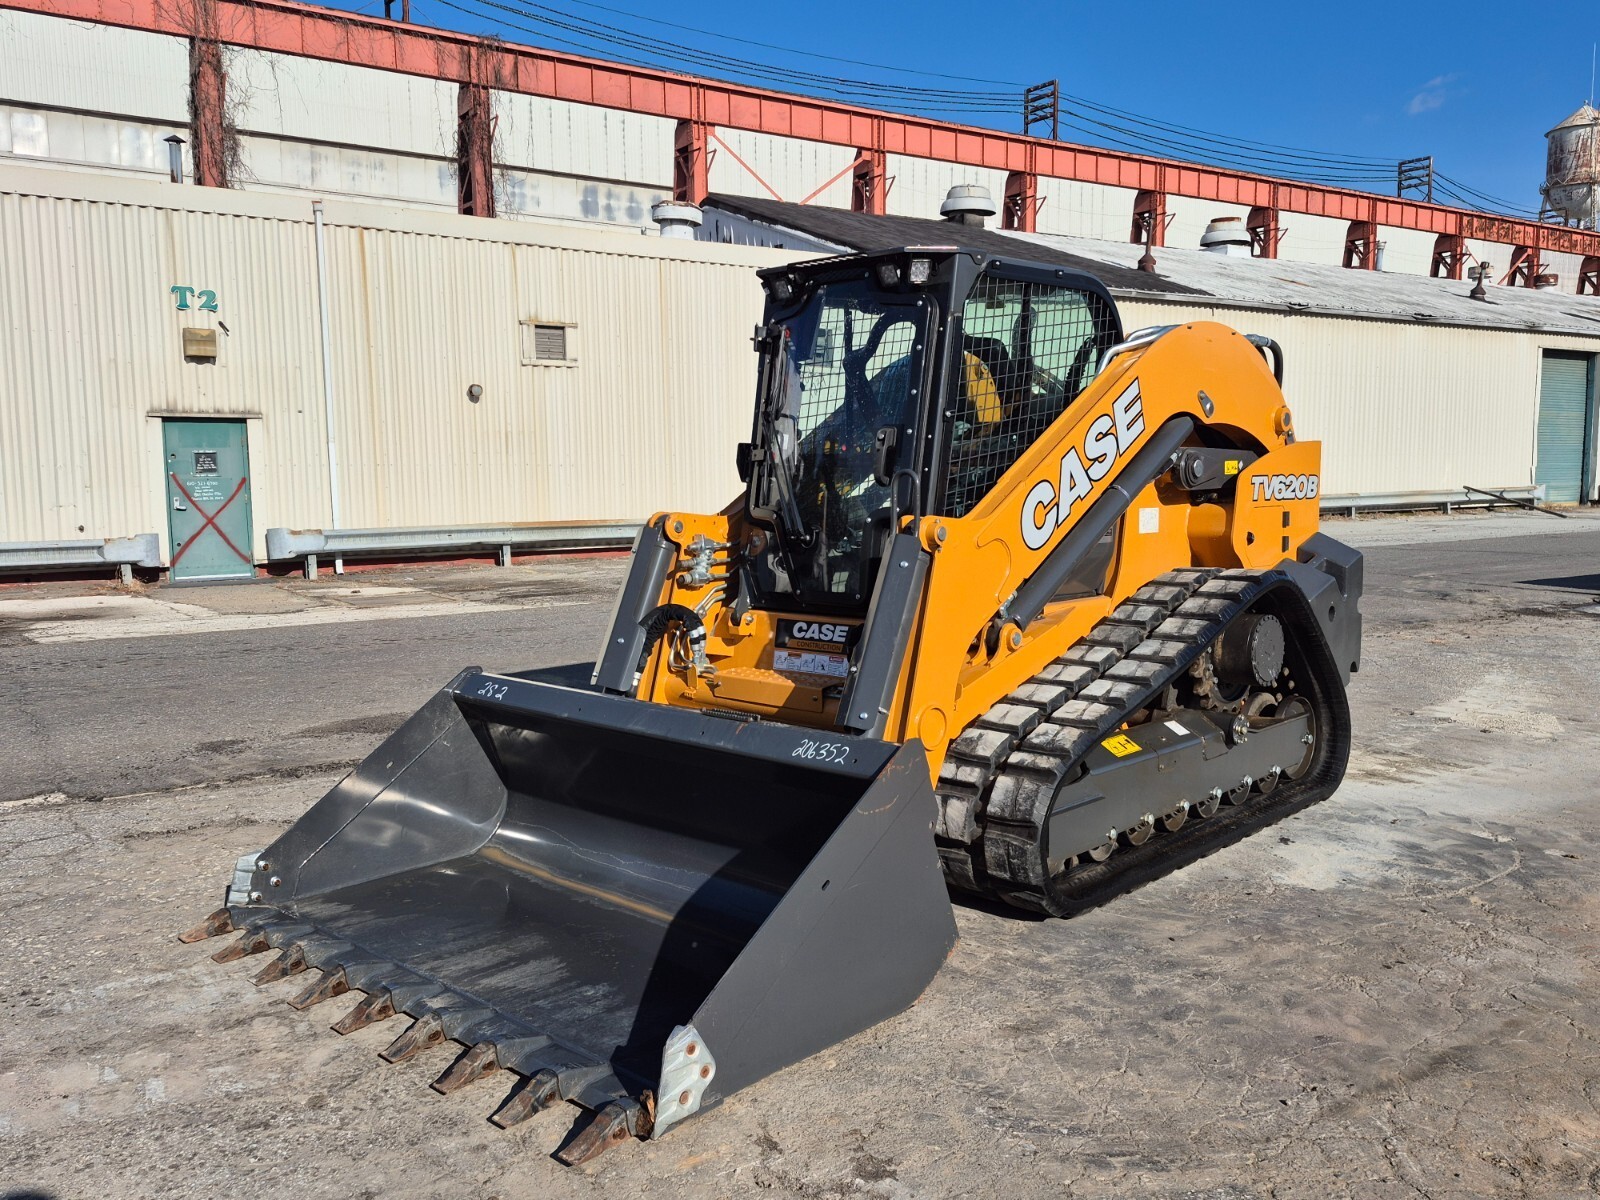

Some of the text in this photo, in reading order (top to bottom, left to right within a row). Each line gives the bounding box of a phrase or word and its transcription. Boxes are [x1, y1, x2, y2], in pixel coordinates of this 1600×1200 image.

[170, 285, 218, 311] T2
[1020, 377, 1145, 550] CASE
[1251, 474, 1319, 501] TV620B
[792, 621, 849, 642] CASE
[796, 640, 842, 651] CONSTRUCTION
[477, 681, 509, 701] 282
[791, 739, 850, 765] 206352
